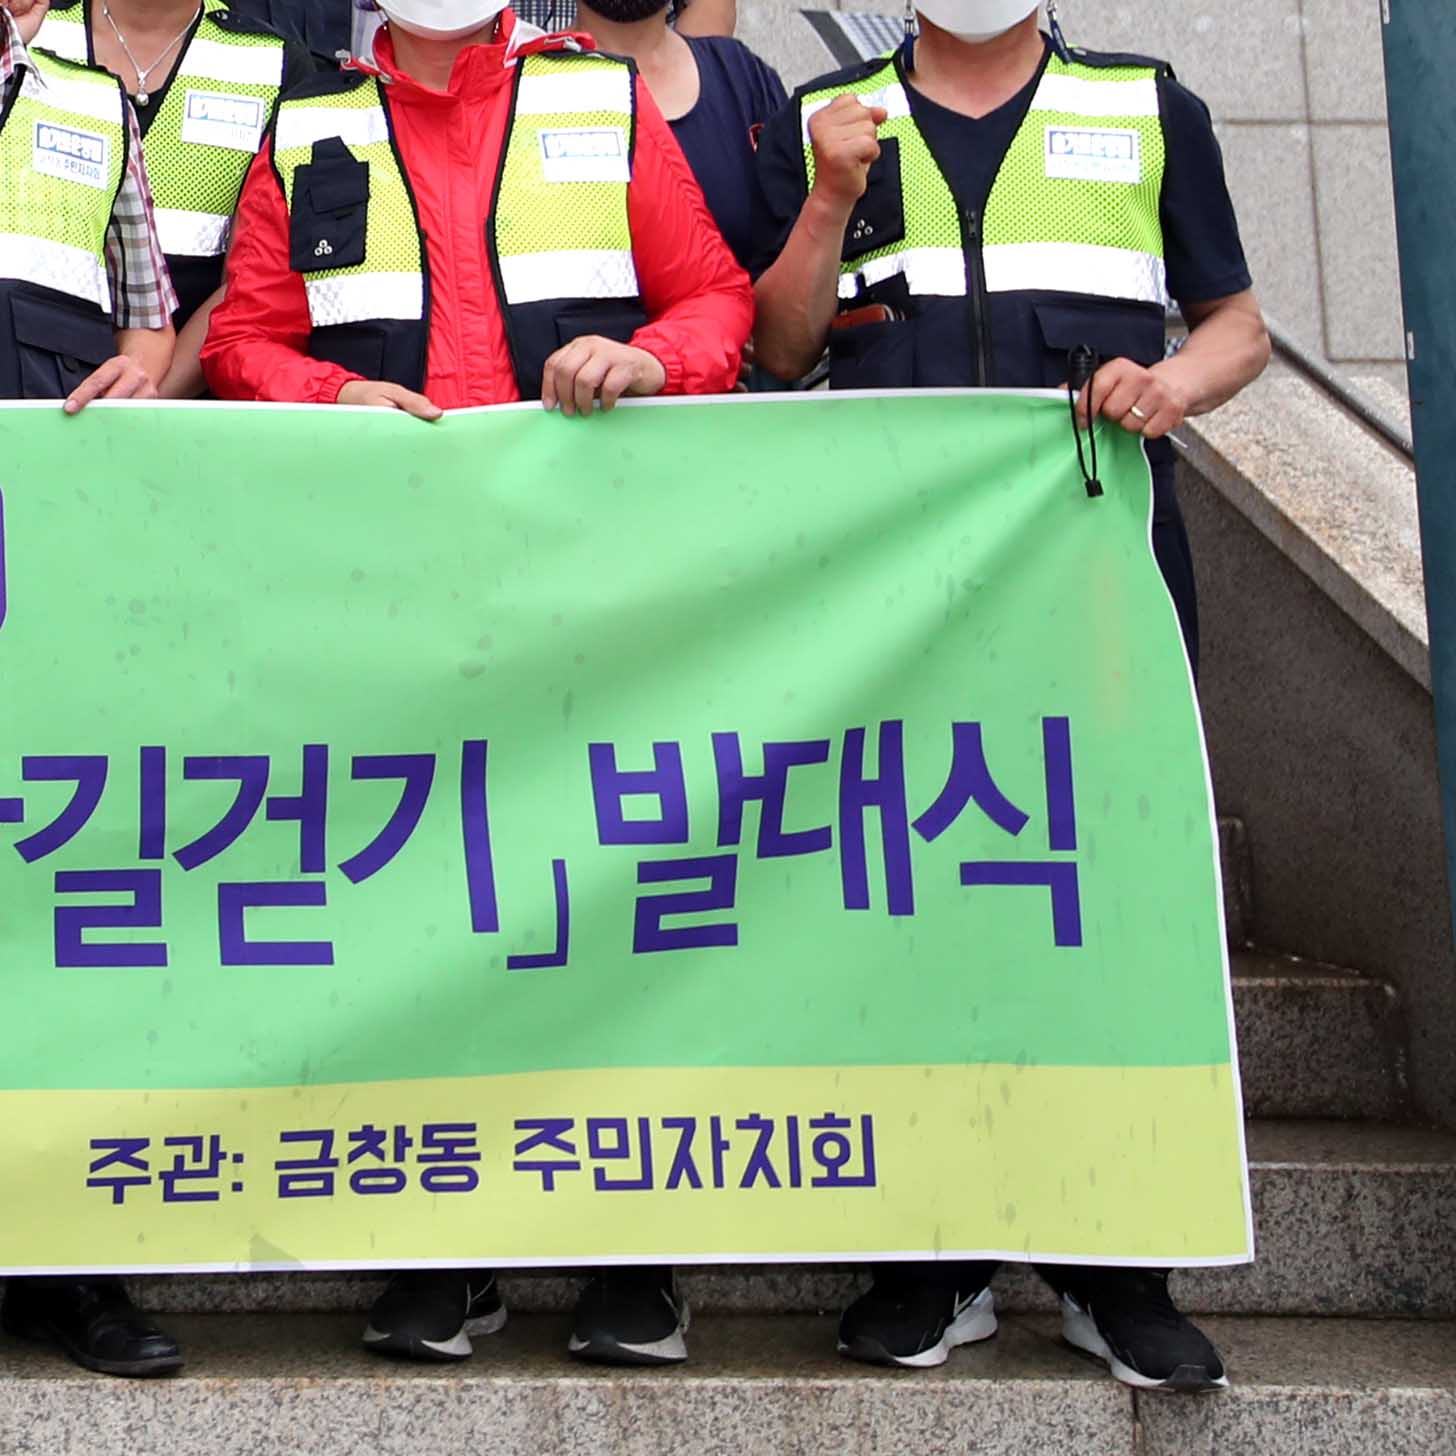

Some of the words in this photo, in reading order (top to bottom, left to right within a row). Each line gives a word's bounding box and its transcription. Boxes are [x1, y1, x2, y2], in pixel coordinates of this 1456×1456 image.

[588, 716, 1083, 954] 발대식
[87, 1134, 244, 1205] 주관:
[276, 1123, 482, 1198] 금창동
[514, 1113, 877, 1192] 주민자치회
